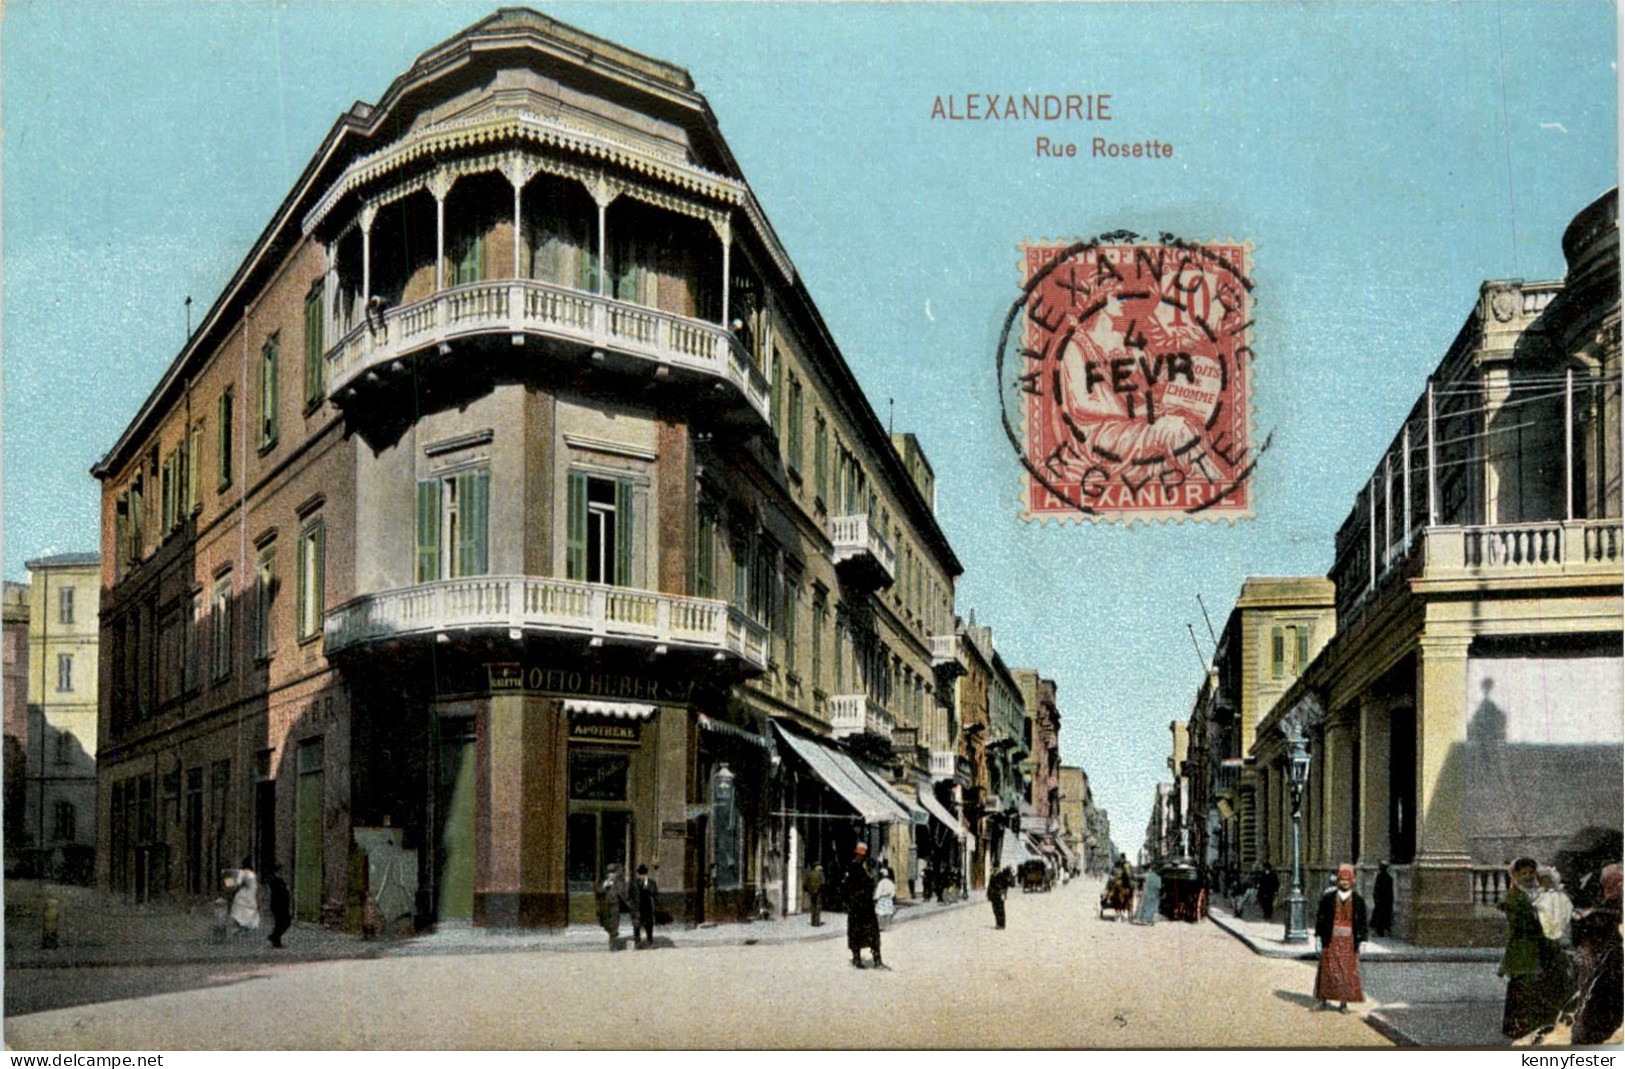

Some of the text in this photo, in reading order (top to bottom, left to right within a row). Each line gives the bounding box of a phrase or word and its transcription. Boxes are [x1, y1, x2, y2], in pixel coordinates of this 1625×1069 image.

[1124, 318, 1147, 350] 4
[1086, 352, 1195, 394] FEVR
[1166, 382, 1217, 405] L'HOMME
[1043, 483, 1237, 508] ALEXANDRIE
[574, 724, 635, 738] APOTHEKE
